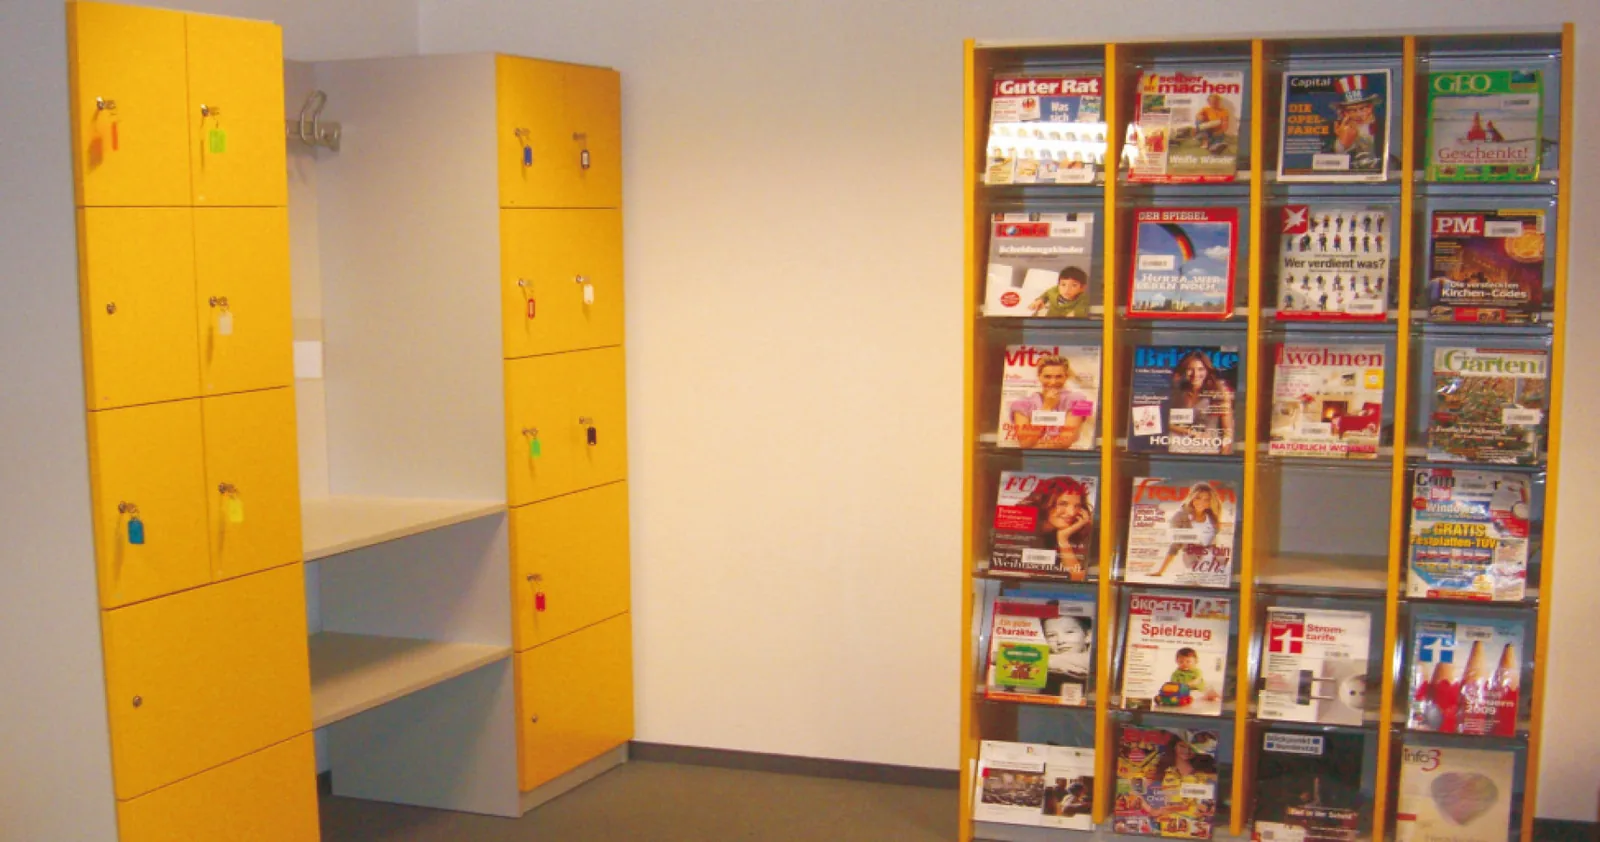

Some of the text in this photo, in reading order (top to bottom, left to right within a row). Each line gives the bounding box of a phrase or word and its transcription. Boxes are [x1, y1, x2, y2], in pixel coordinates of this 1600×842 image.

[1000, 80, 1059, 95] Guter
[1061, 78, 1099, 94] Rat
[1158, 80, 1240, 94] machen
[1290, 77, 1331, 88] Capital
[1434, 73, 1492, 94] GEO
[1051, 101, 1069, 112] Was
[1288, 103, 1312, 113] DIE
[1287, 125, 1330, 135] FARCE
[1438, 146, 1528, 160] Geschenkt!
[1138, 211, 1208, 221] DER SPIEGEL
[1284, 257, 1386, 270] Wer verdient was?
[1135, 347, 1239, 369] Brite
[1286, 348, 1384, 367] wohnen
[1443, 349, 1538, 374] Garten
[1149, 435, 1232, 448] HOROSKOP
[1132, 478, 1238, 504] freun
[1433, 522, 1486, 538] GRATIS
[996, 626, 1040, 637] Charakter
[1141, 623, 1212, 641] Spielzeug
[1307, 624, 1347, 634] Strom-
[1306, 632, 1336, 642] tarife
